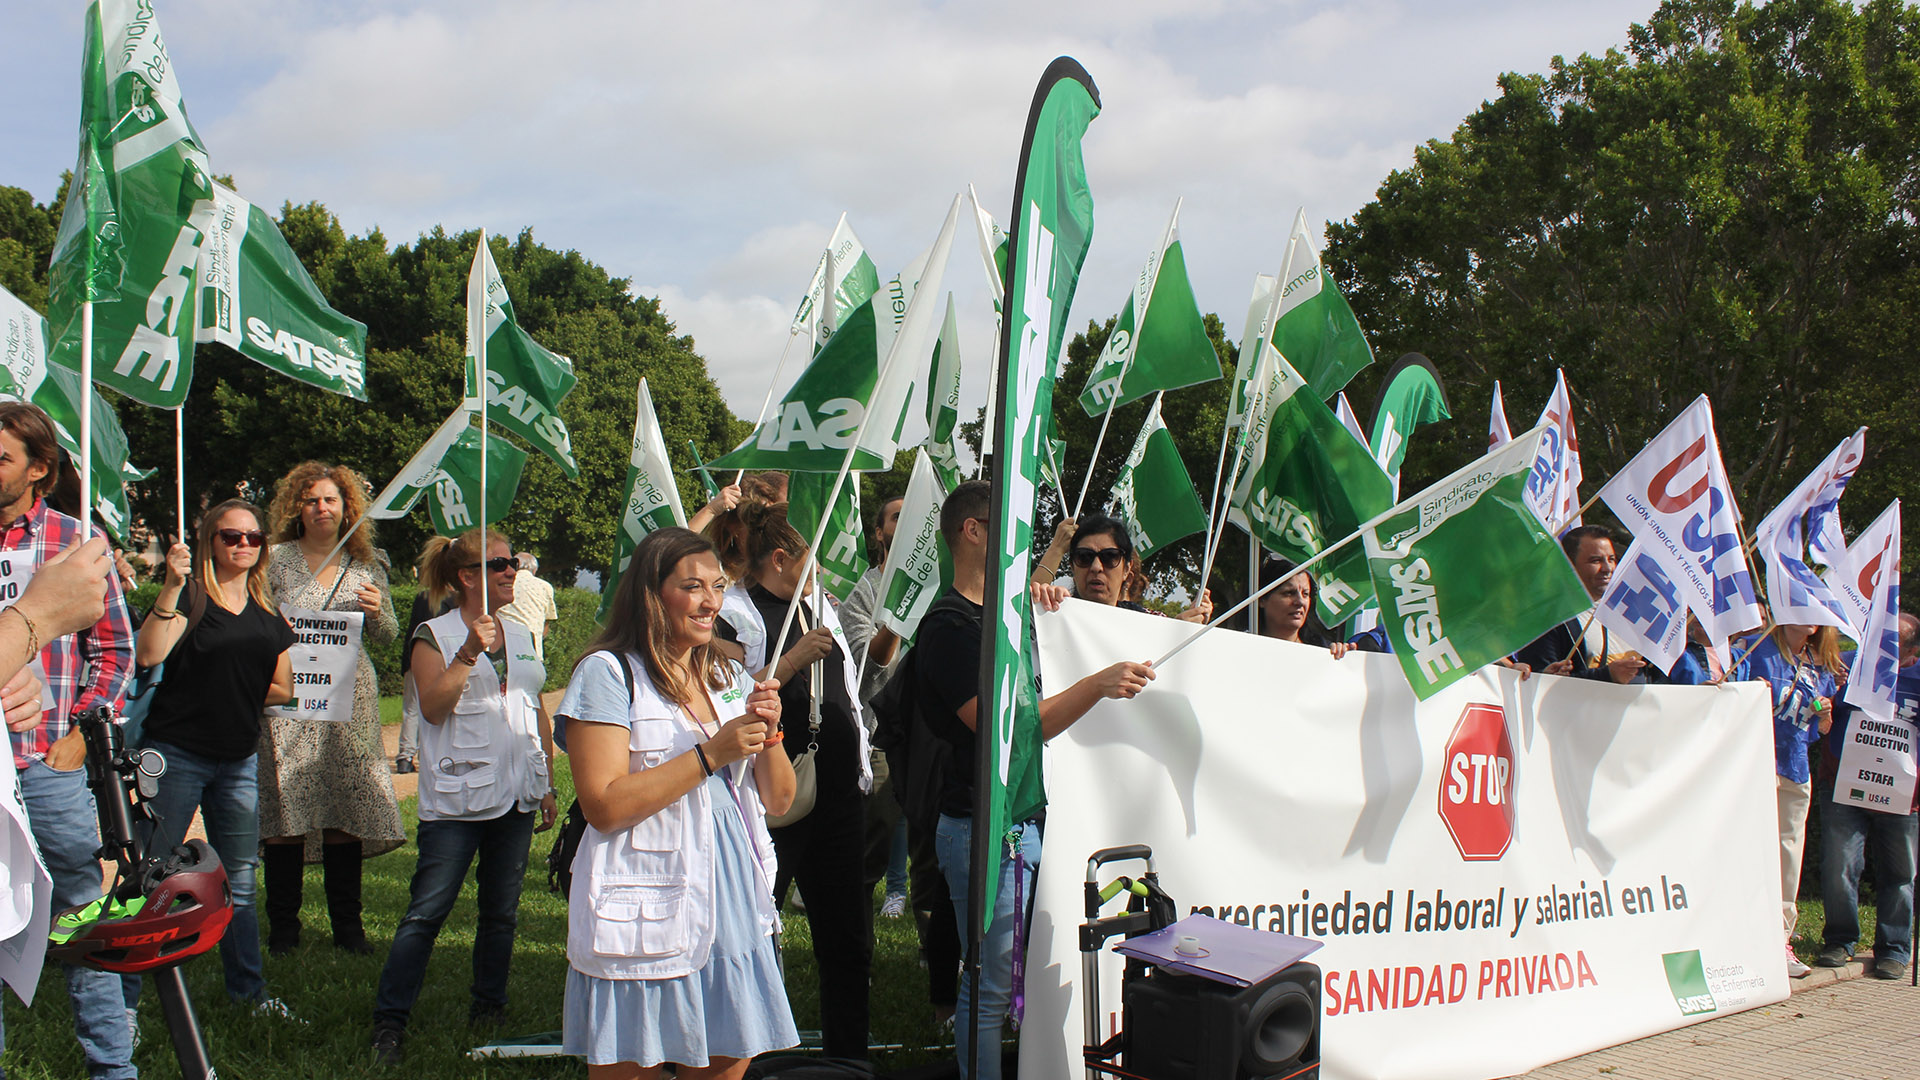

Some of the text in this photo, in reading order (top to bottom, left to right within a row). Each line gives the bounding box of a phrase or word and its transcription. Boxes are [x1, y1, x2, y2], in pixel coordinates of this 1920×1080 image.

[247, 317, 365, 391] SATSE
[1424, 471, 1492, 516] Sindicato
[1423, 512, 1442, 528] de
[1626, 493, 1650, 522] UNIÓN
[1647, 519, 1680, 562] SINDICAL
[1676, 555, 1684, 563] Y
[1680, 558, 1710, 599] TÉCNICOS
[917, 559, 934, 582] de
[288, 616, 348, 631] CONVENIO
[1388, 558, 1465, 685] SATSE
[293, 632, 348, 646] OLECTIVO
[292, 672, 332, 685] ESTAFA
[1860, 719, 1909, 740] CONVENIO
[1855, 732, 1909, 754] COLECTIVO
[1448, 751, 1510, 806] STOP
[1857, 769, 1894, 787] ESTAFA
[1190, 875, 1689, 938] recariedad laboral y salarial en la
[111, 927, 181, 948] LAZER
[1705, 964, 1744, 980] Sindicato
[1325, 950, 1599, 1017] SANIDAD PRIVADA
[1711, 983, 1722, 994] de
[1678, 994, 1716, 1014] SATSE
